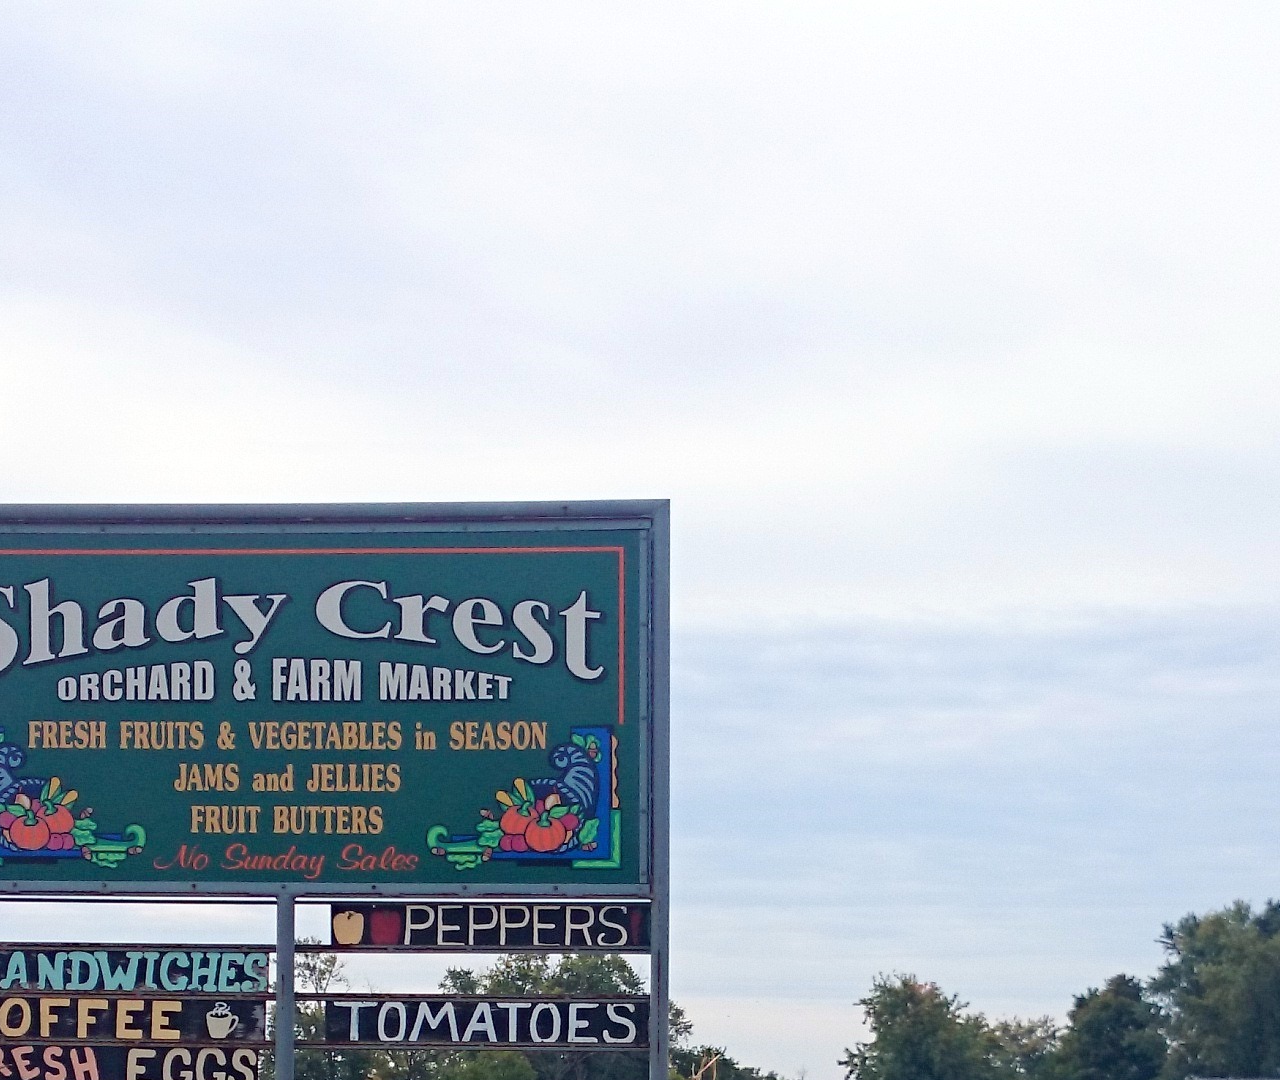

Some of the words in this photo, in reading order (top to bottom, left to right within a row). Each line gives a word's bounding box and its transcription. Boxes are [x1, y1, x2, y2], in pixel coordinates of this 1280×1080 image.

[315, 580, 606, 681] Crest
[57, 661, 216, 703] ORCHARD
[232, 659, 257, 702] &
[271, 658, 362, 702] FARM
[379, 661, 512, 701] MARKET
[27, 720, 108, 750] FRESH
[119, 720, 204, 750] FRUITS
[217, 722, 236, 751] &
[248, 720, 403, 751] VEGETABLES
[415, 720, 436, 750] in
[450, 720, 547, 751] SEASON
[173, 763, 240, 793] JAMS
[252, 764, 295, 792] and
[307, 763, 401, 793] JELLIES
[190, 806, 262, 836] FRUIT
[272, 806, 384, 835] BUTTERS
[154, 845, 209, 870] No
[221, 843, 325, 879] Sunday
[336, 844, 417, 870] Sales
[404, 906, 628, 946] PEPPERS
[334, 1001, 636, 1043] TOMATOES
